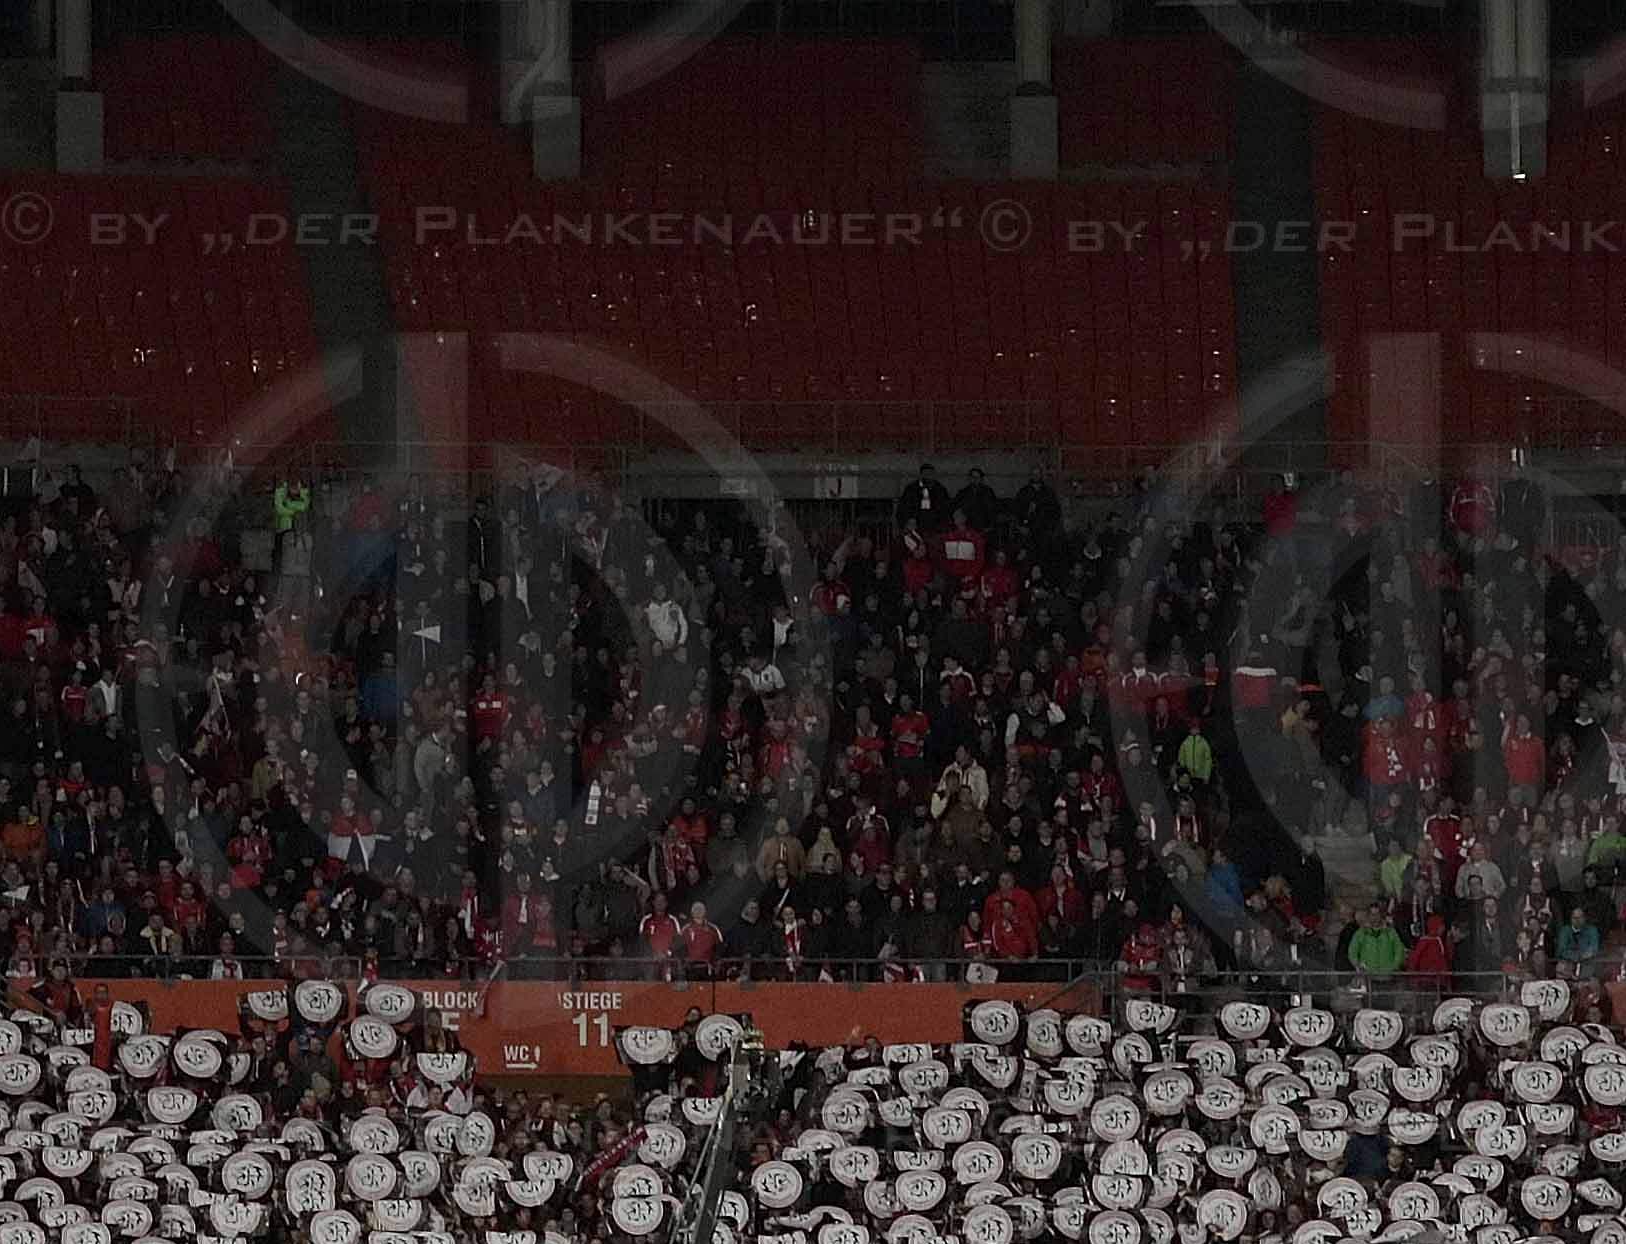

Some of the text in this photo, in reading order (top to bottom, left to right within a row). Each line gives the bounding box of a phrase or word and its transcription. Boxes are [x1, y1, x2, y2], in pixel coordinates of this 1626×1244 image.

[423, 991, 477, 1009] BLOCK
[562, 991, 622, 1010] STIEGE
[572, 1012, 608, 1047] 11
[503, 1044, 529, 1062] WC
